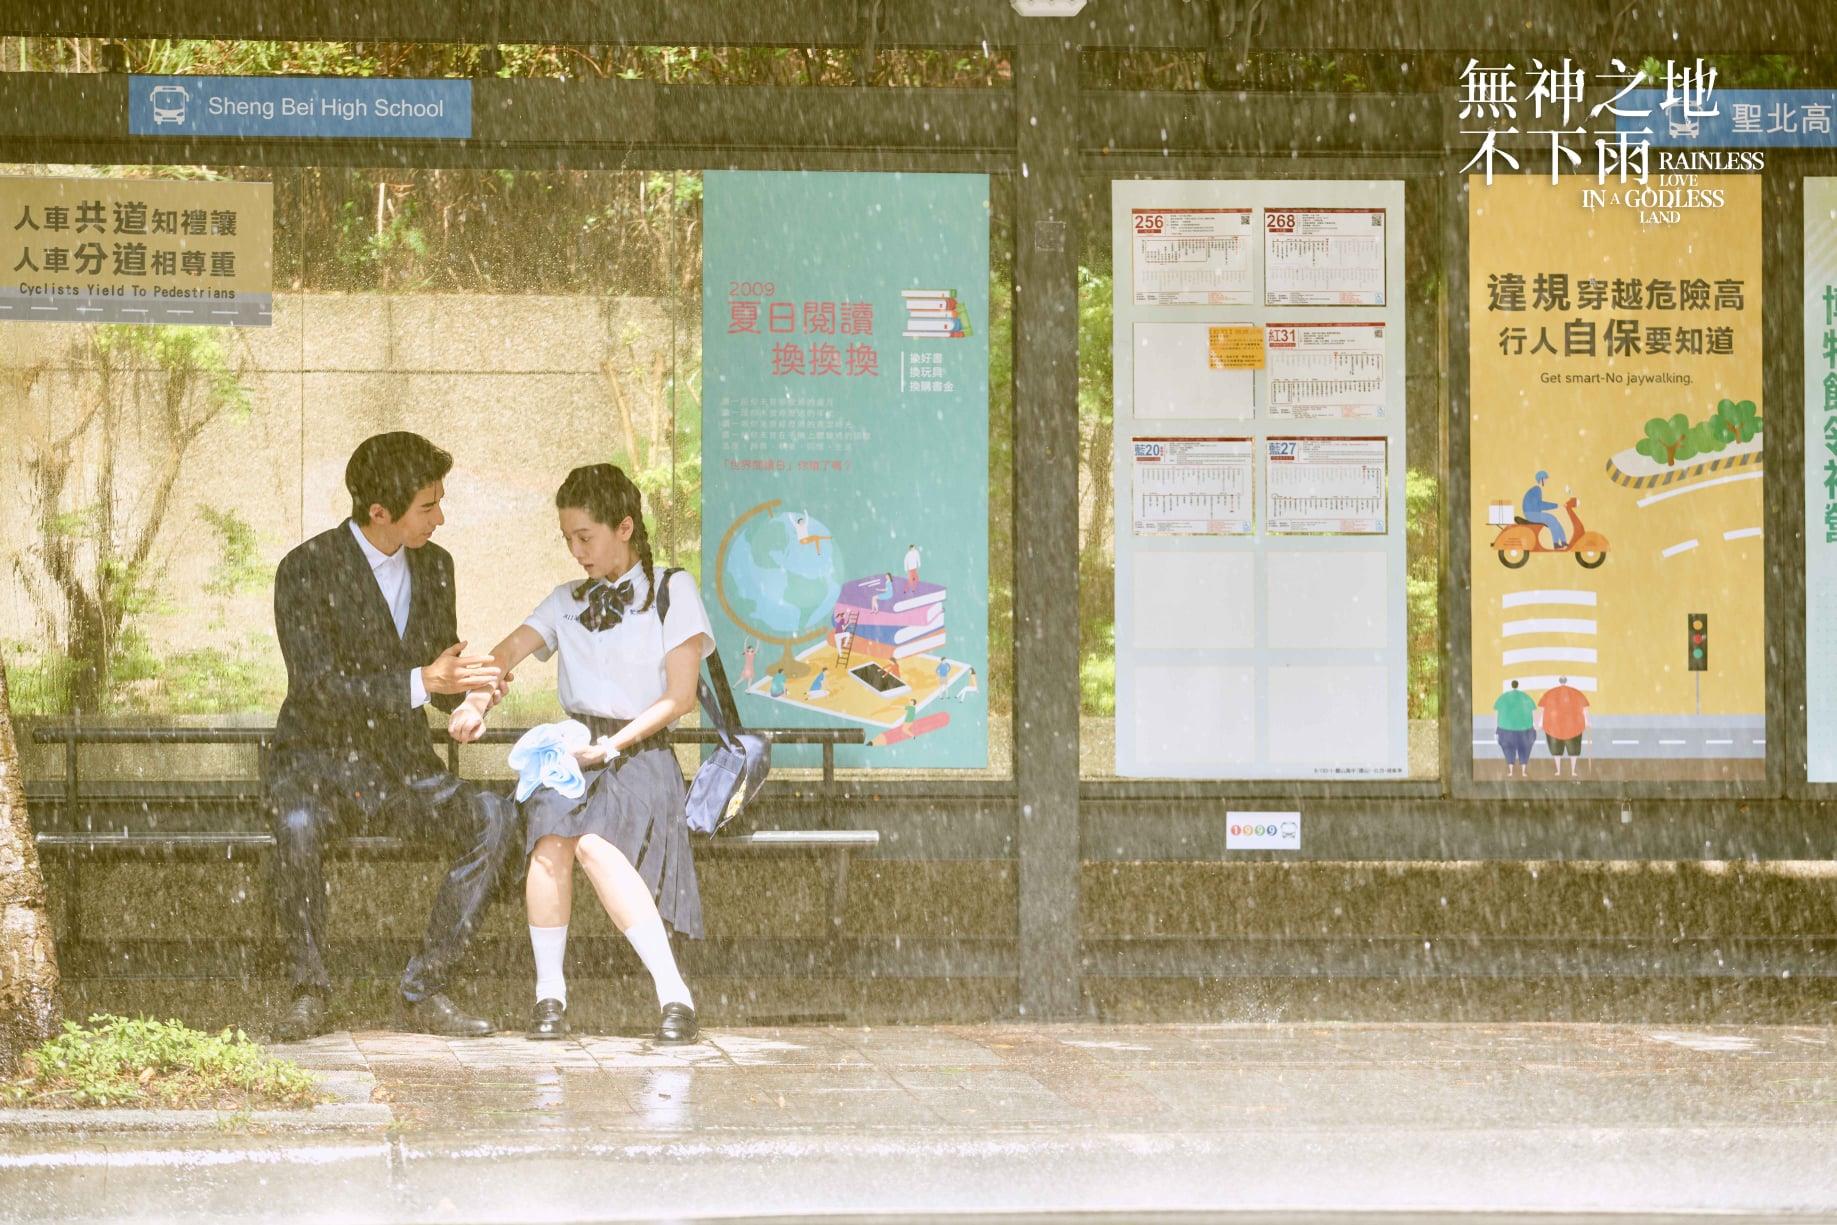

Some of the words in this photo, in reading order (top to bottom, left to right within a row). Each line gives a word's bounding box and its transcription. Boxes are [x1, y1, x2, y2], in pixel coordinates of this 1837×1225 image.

[208, 96, 274, 120] Sheng
[281, 97, 314, 116] Bei
[321, 97, 367, 121] High
[374, 98, 444, 117] School
[1731, 102, 1832, 134] 聖北高
[14, 200, 237, 237] 人車共道知禮讓
[1134, 215, 1164, 229] 256
[1266, 214, 1296, 228] 268
[14, 242, 237, 278] 人車分道相尊重
[19, 282, 80, 297] Cyclists
[87, 284, 125, 297] Yield
[132, 285, 146, 297] To
[154, 286, 236, 299] Pedestrians
[728, 281, 776, 297] 2009
[1487, 273, 1745, 312] 違規穿越危險高
[727, 300, 874, 336] 夏日閱讀
[1499, 318, 1734, 357] 行人自保要知道
[771, 342, 880, 377] 換換換
[1540, 372, 1562, 384] Get
[1565, 372, 1623, 384] smart-No
[1626, 372, 1694, 386] jaywalking.
[1230, 824, 1277, 837] 1999
